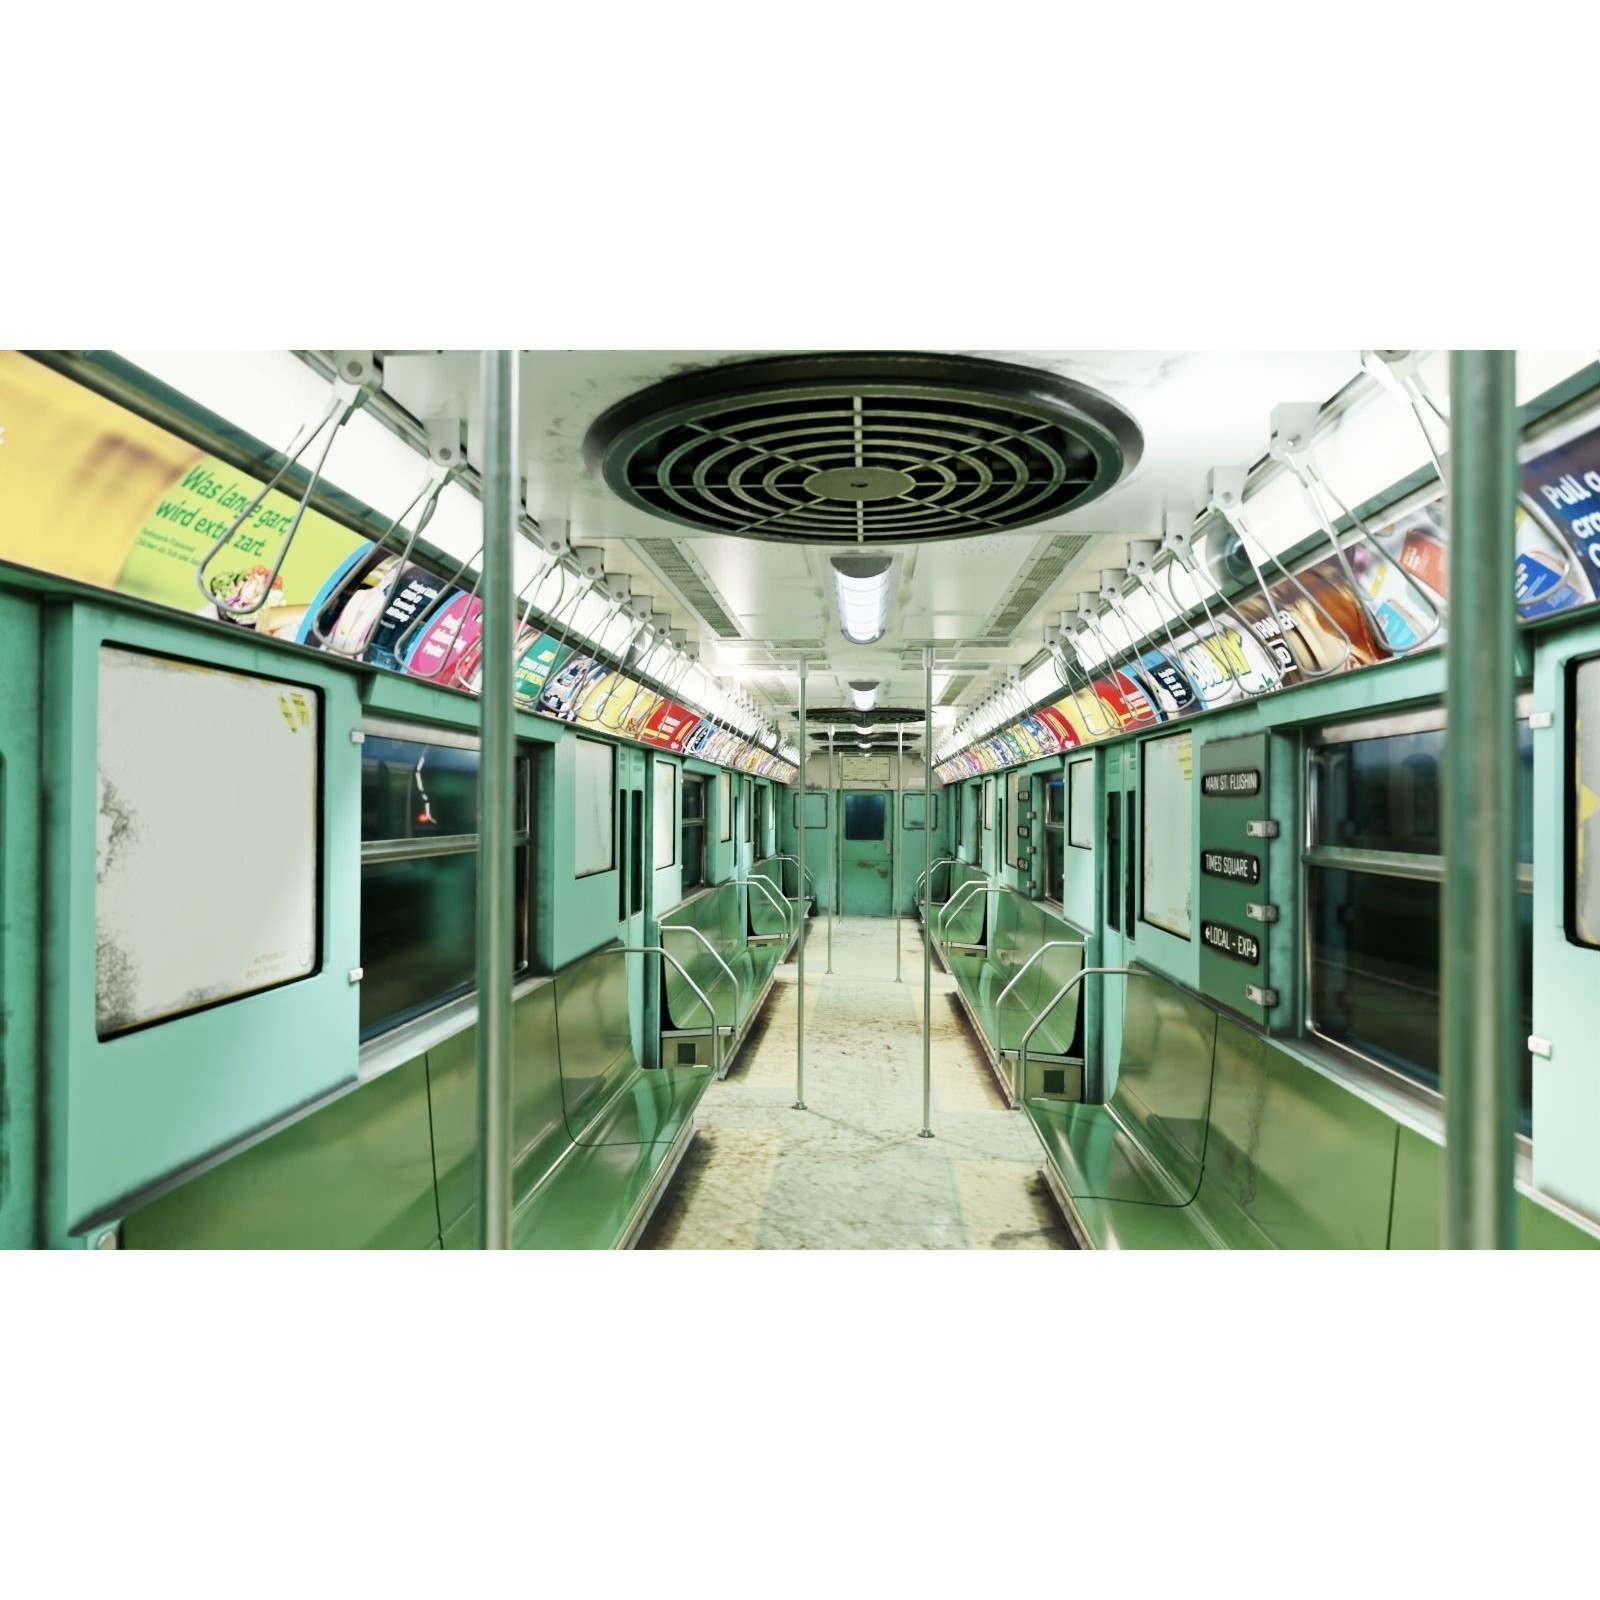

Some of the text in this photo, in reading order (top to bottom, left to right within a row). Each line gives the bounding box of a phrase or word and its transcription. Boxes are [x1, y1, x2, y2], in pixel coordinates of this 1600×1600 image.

[181, 465, 223, 499] Was
[1540, 473, 1592, 510] Pull
[156, 500, 202, 527] wird
[194, 517, 235, 545] extr
[233, 534, 266, 557] zart
[1205, 775, 1219, 791] MAIN
[1205, 853, 1222, 873] TIMES
[1223, 856, 1248, 877] SQUARE
[1210, 925, 1231, 950] LOCAL
[1237, 934, 1252, 957] EXP
